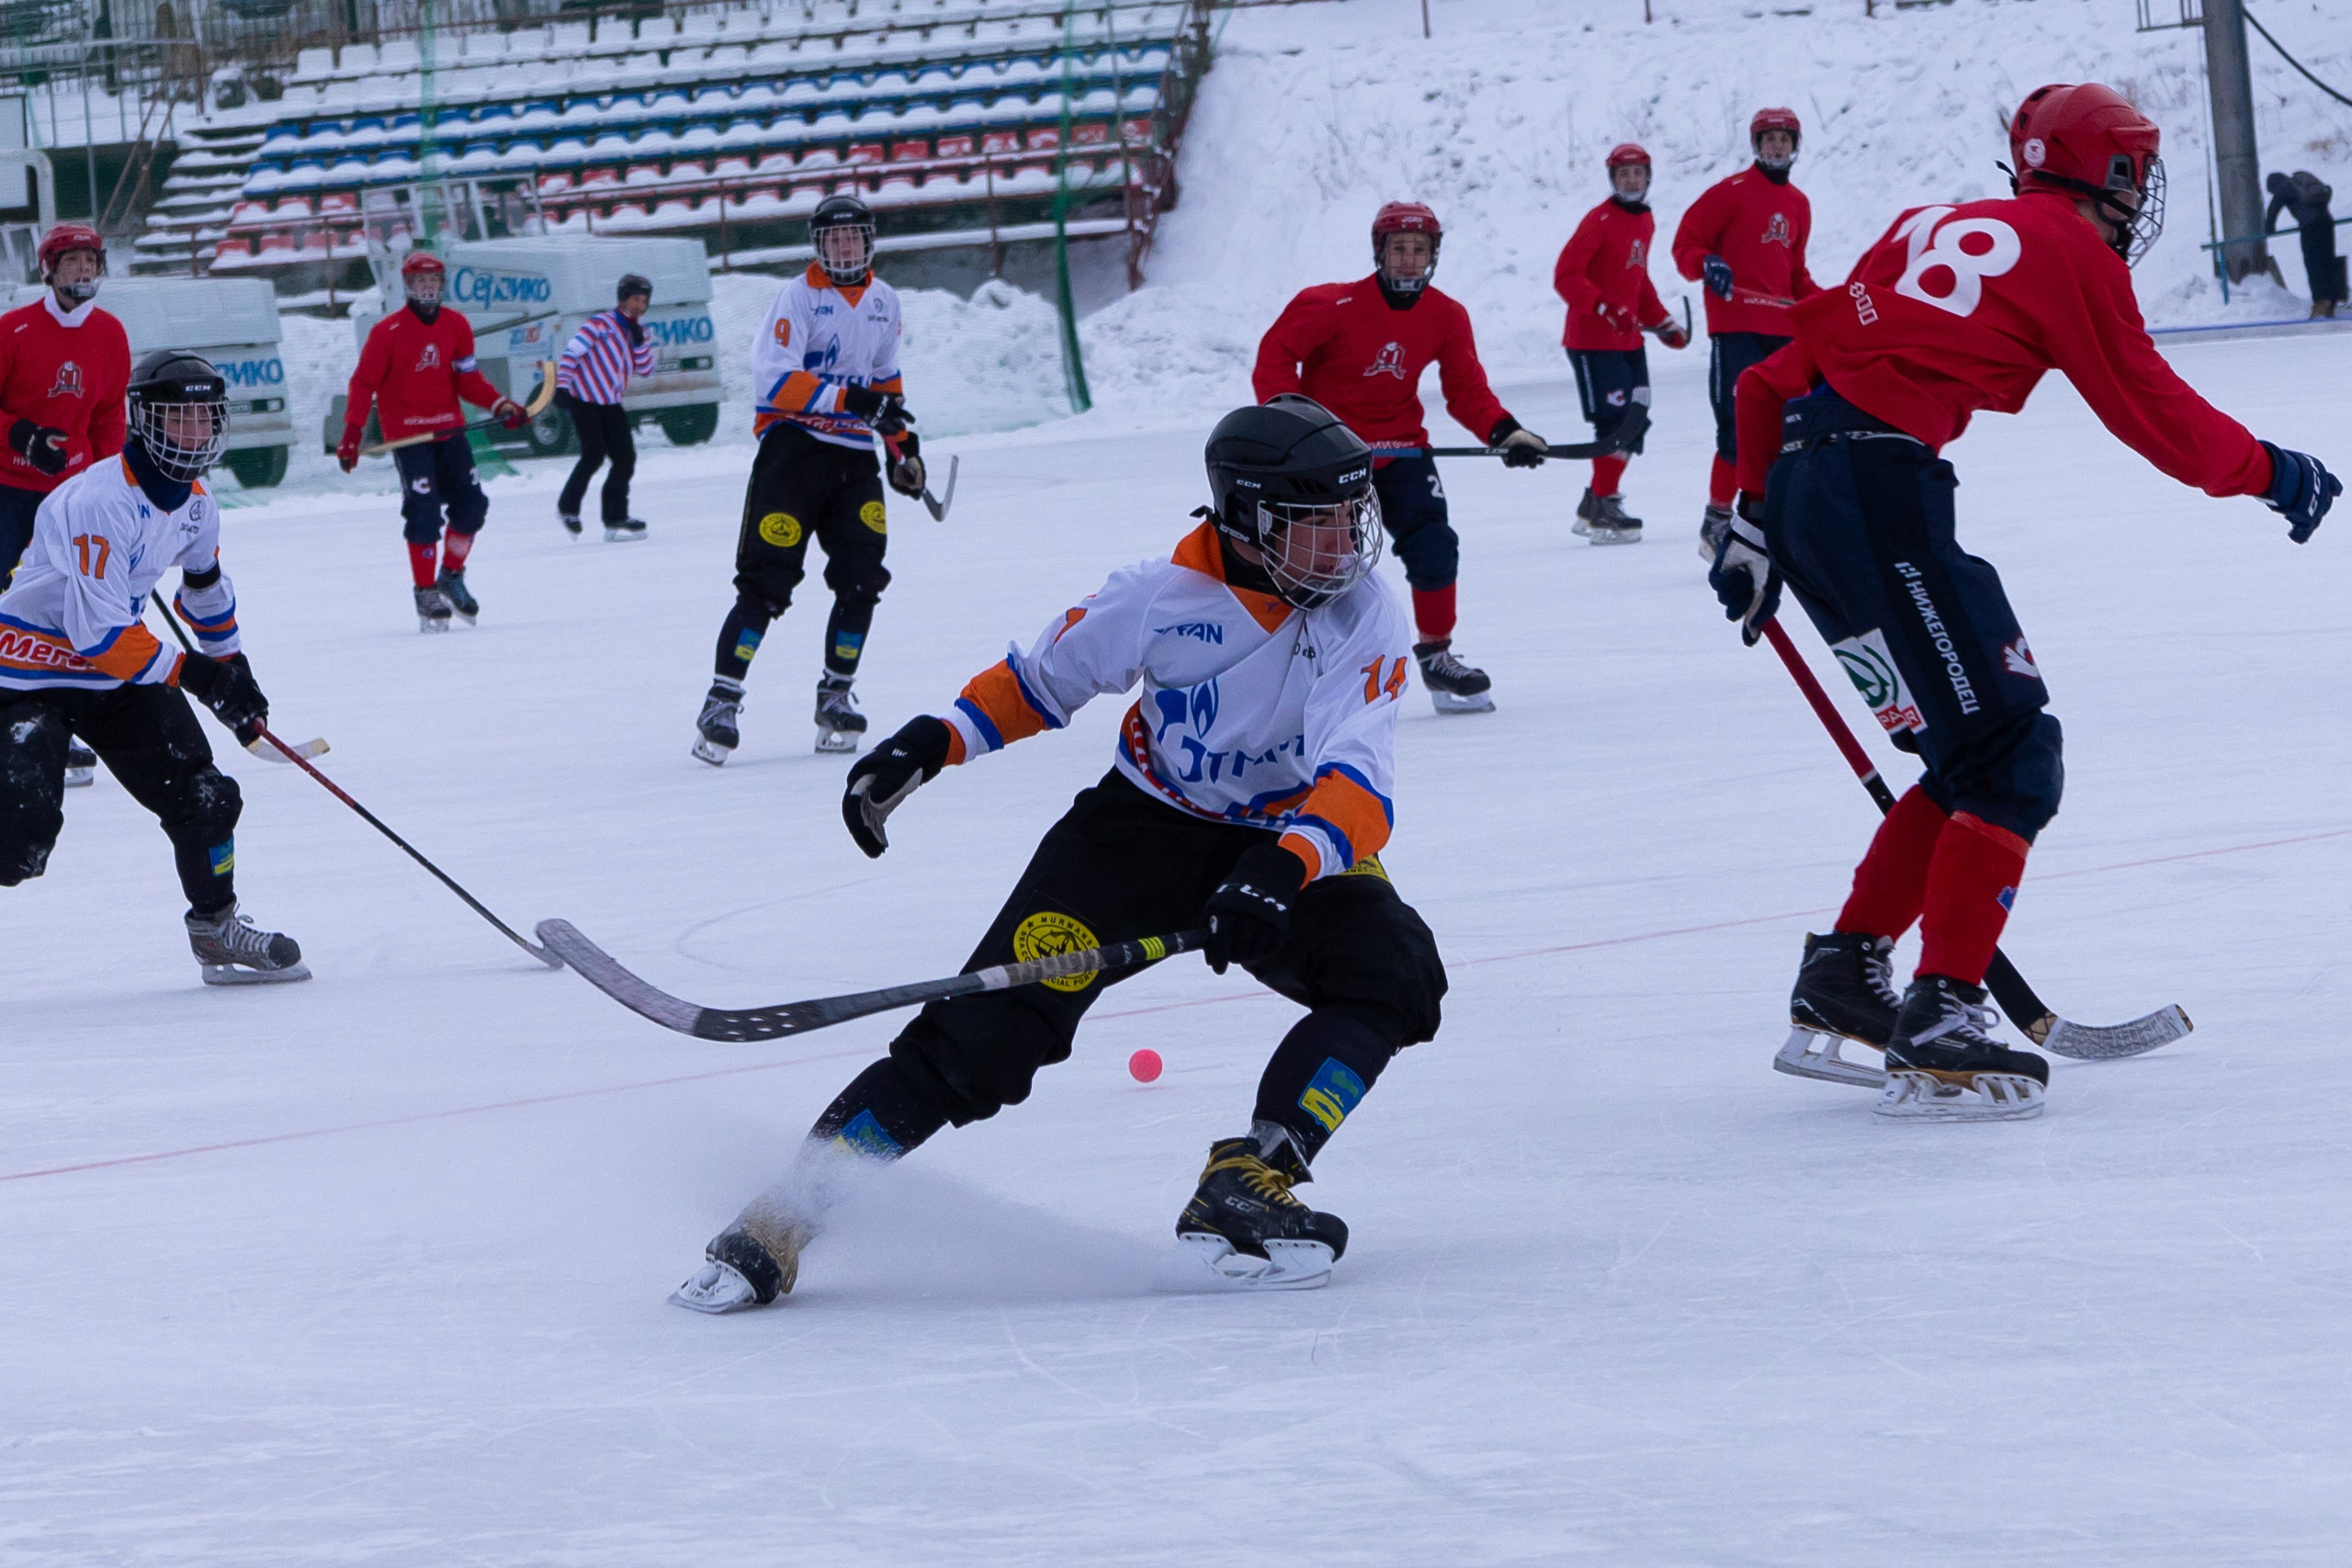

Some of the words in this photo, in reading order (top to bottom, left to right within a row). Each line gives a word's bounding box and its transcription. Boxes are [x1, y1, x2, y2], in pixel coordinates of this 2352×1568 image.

[1891, 205, 2021, 318] 18
[775, 318, 790, 348] 9
[1236, 479, 1261, 490] CCM
[1339, 468, 1367, 484] CCM
[74, 533, 110, 580] 17
[1905, 581, 1980, 715] НИЖЕГОРОДЕЦ
[1361, 654, 1408, 705] 14
[1041, 917, 1099, 949] MURMANS
